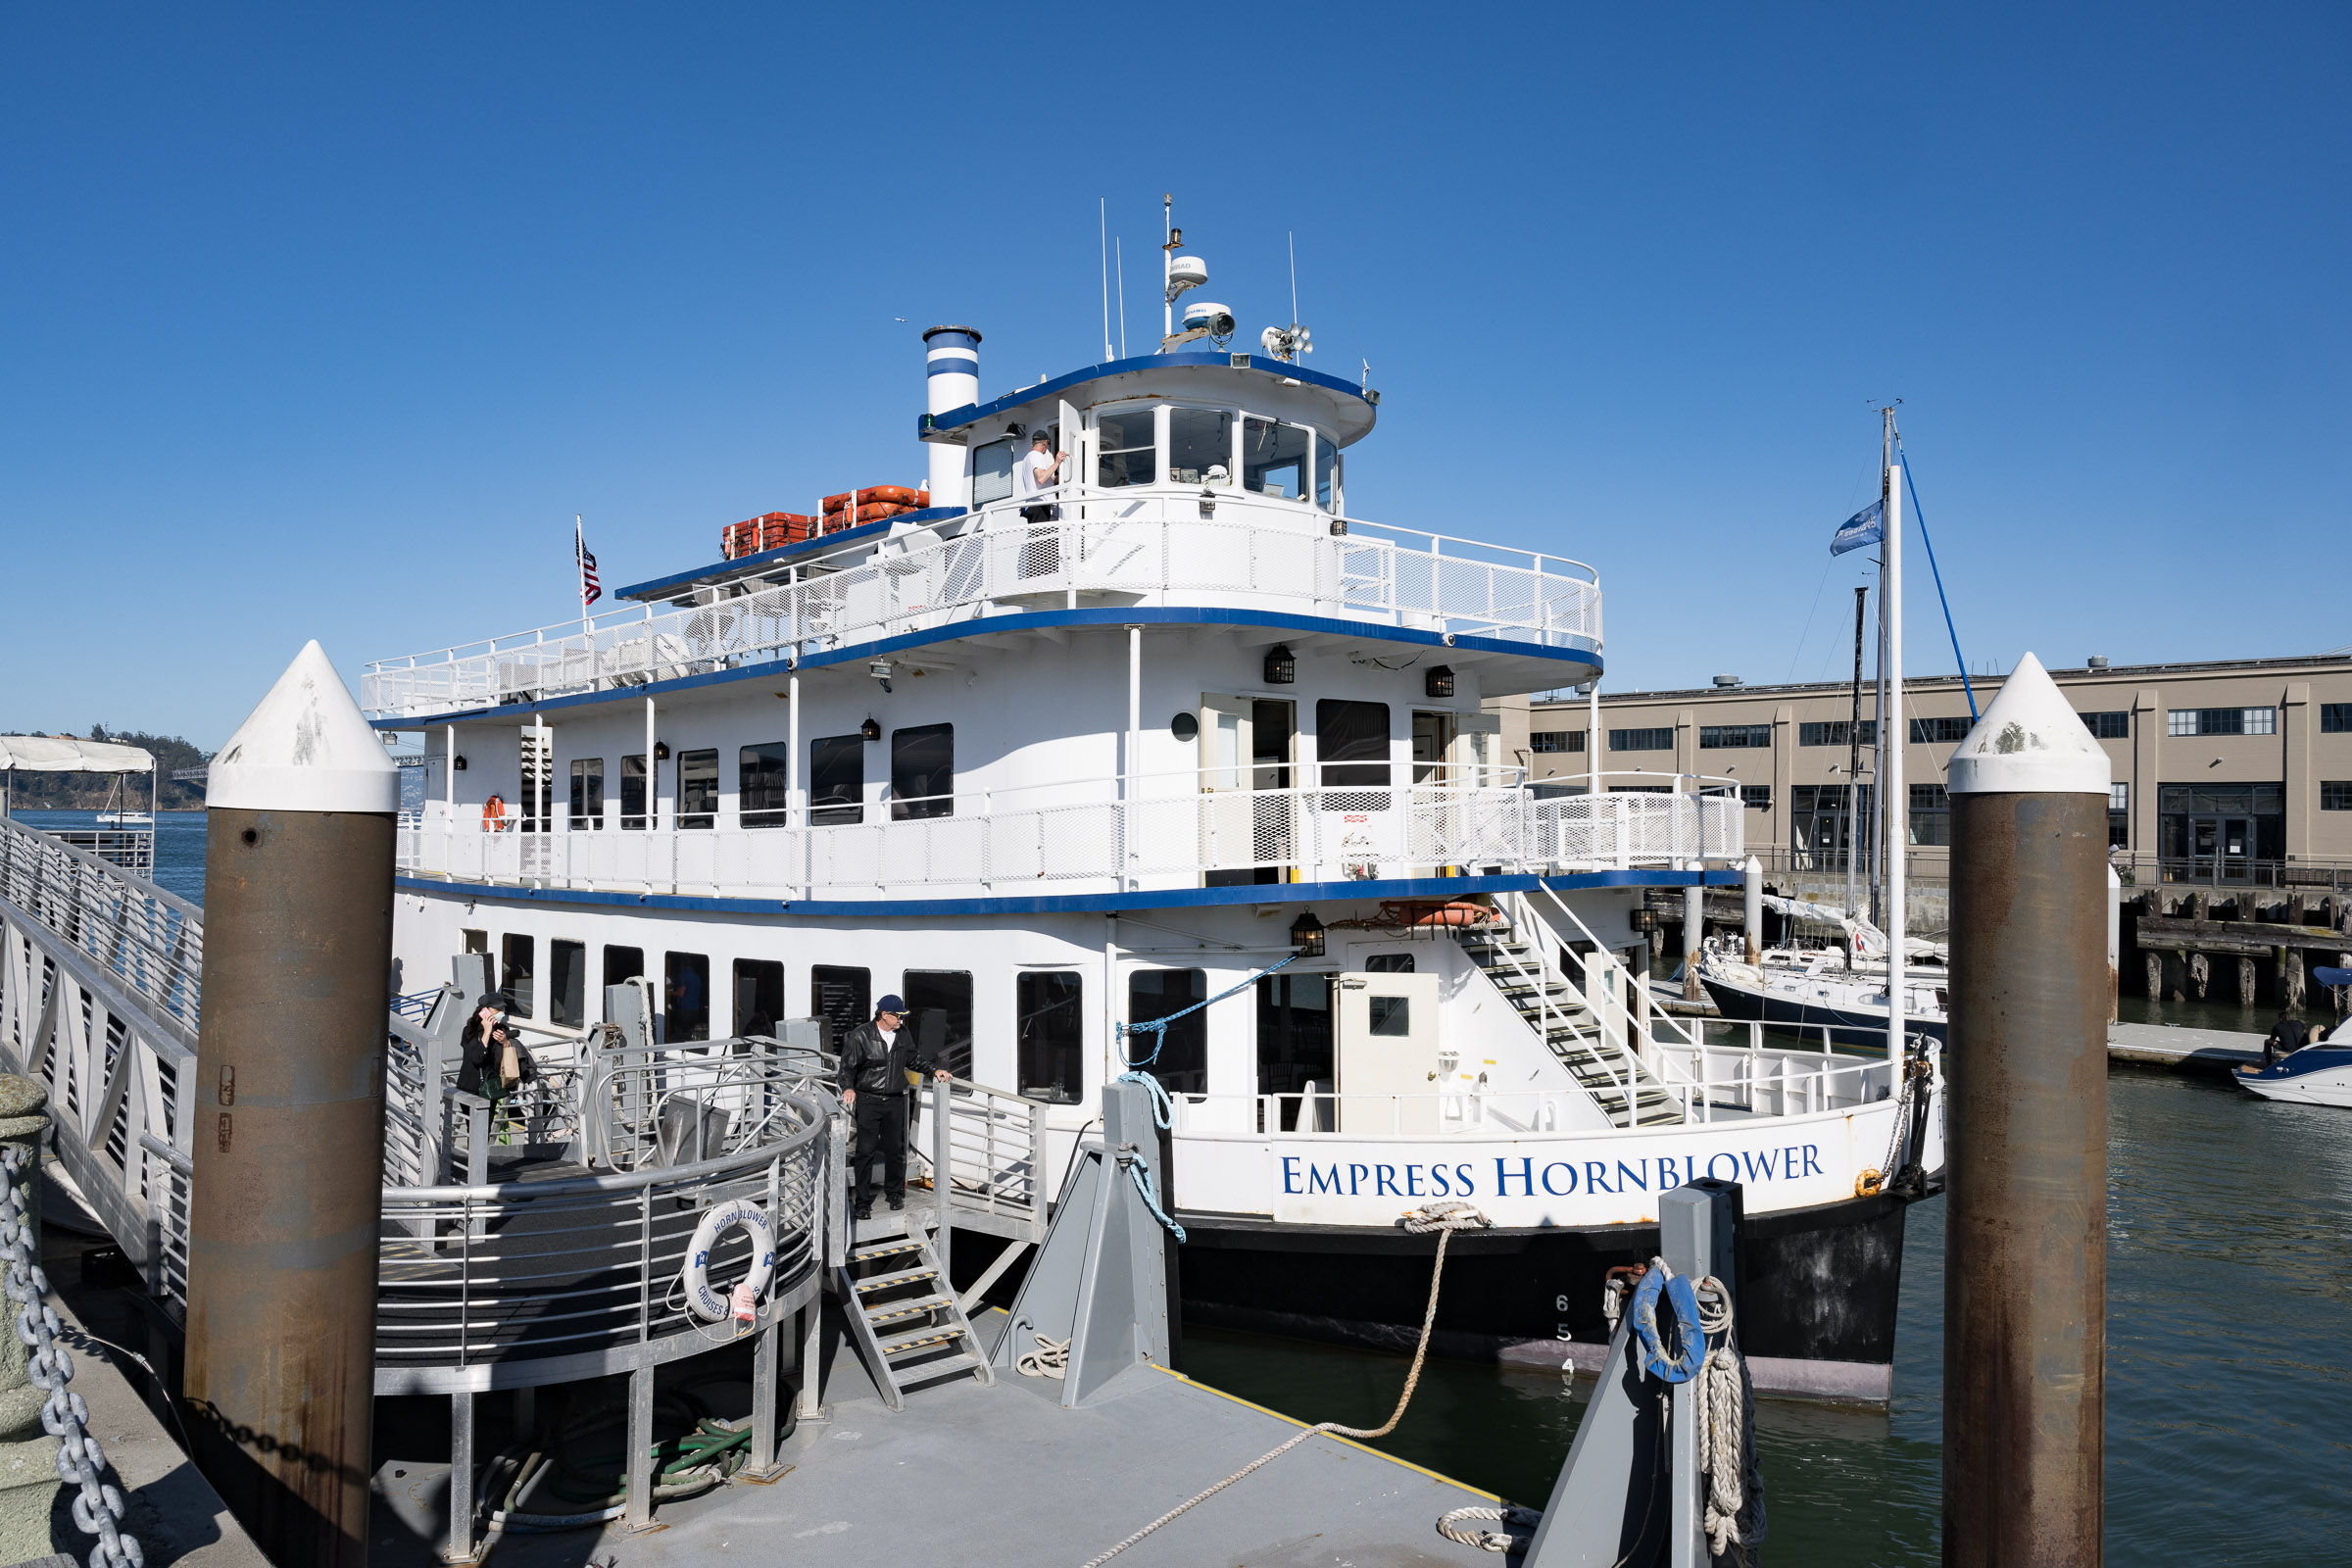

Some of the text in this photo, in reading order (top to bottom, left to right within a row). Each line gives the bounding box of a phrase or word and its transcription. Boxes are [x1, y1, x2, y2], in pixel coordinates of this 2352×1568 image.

[1281, 1144, 1824, 1198] EMPRESS HORNBLOWER
[714, 1209, 767, 1234] HORNBLOWER
[698, 1285, 723, 1315] CRUISES
[1556, 1295, 1568, 1312] 6
[1556, 1323, 1572, 1342] 5
[1561, 1358, 1575, 1375] 4
